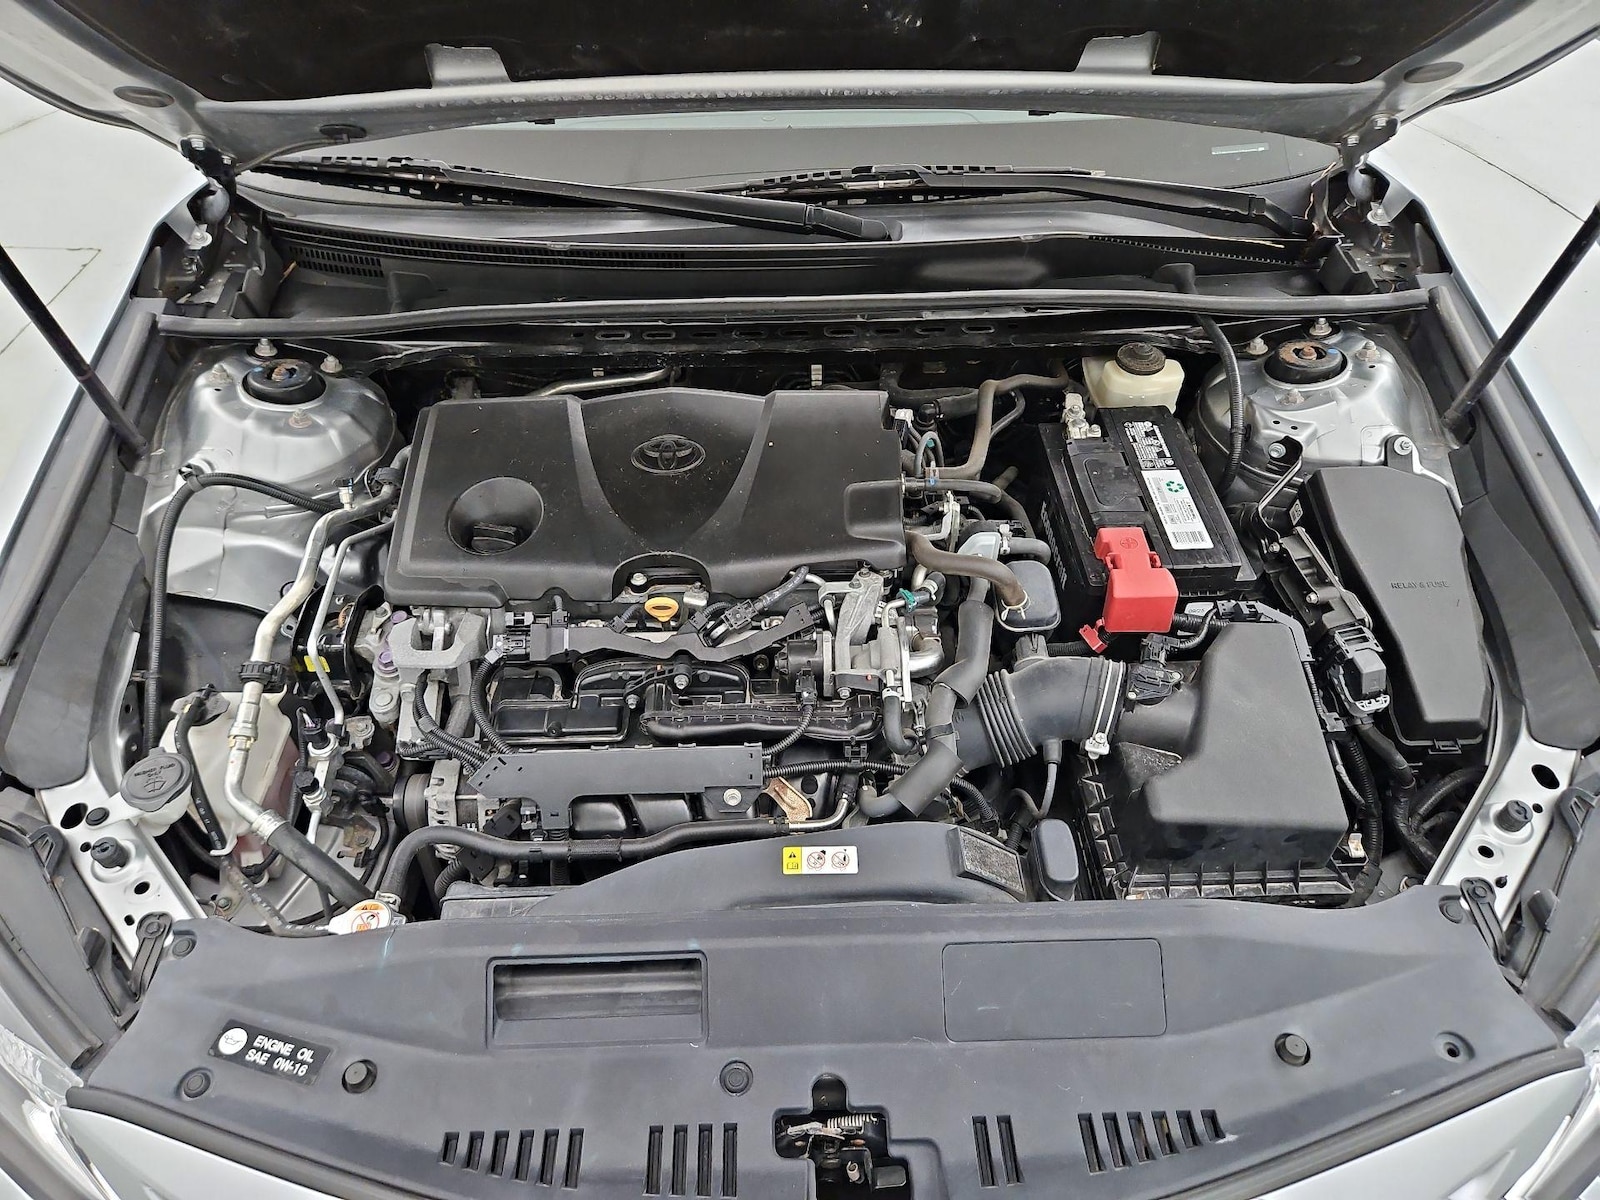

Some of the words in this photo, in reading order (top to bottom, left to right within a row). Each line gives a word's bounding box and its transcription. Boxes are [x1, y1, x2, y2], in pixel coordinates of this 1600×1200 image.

[1390, 581, 1417, 589] RELAY
[1426, 580, 1449, 588] FUSE
[245, 1049, 270, 1066] SAE
[273, 1057, 308, 1077] 0W-16
[253, 1035, 294, 1056] ENGINE
[296, 1047, 315, 1064] OIL
